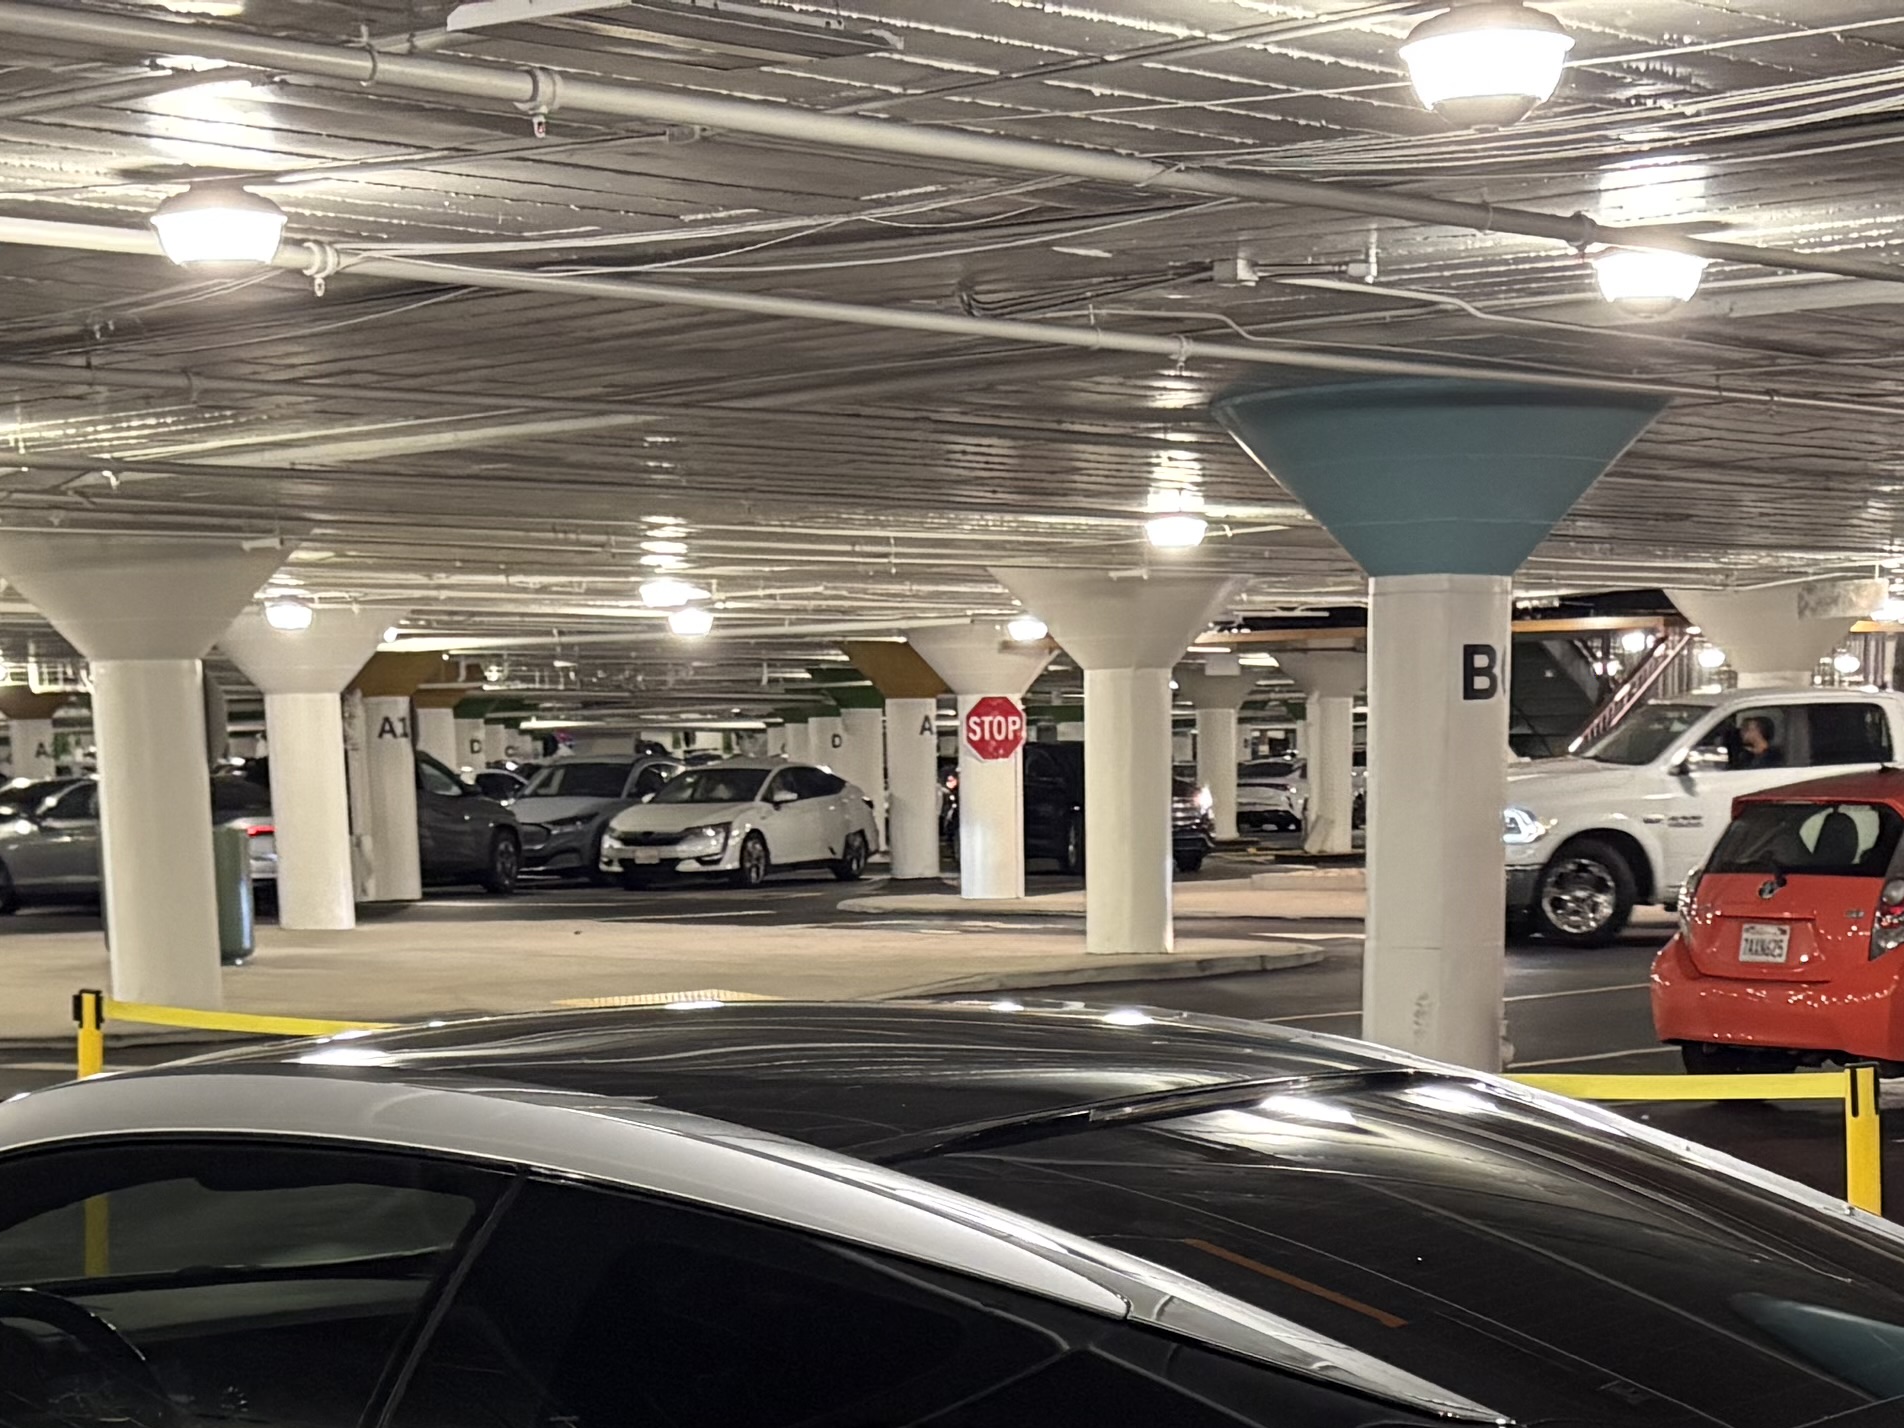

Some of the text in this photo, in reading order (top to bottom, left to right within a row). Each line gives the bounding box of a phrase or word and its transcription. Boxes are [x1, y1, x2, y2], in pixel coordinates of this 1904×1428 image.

[1462, 643, 1507, 701] B
[377, 715, 410, 740] A1
[919, 714, 934, 736] A
[968, 715, 1022, 741] STOP
